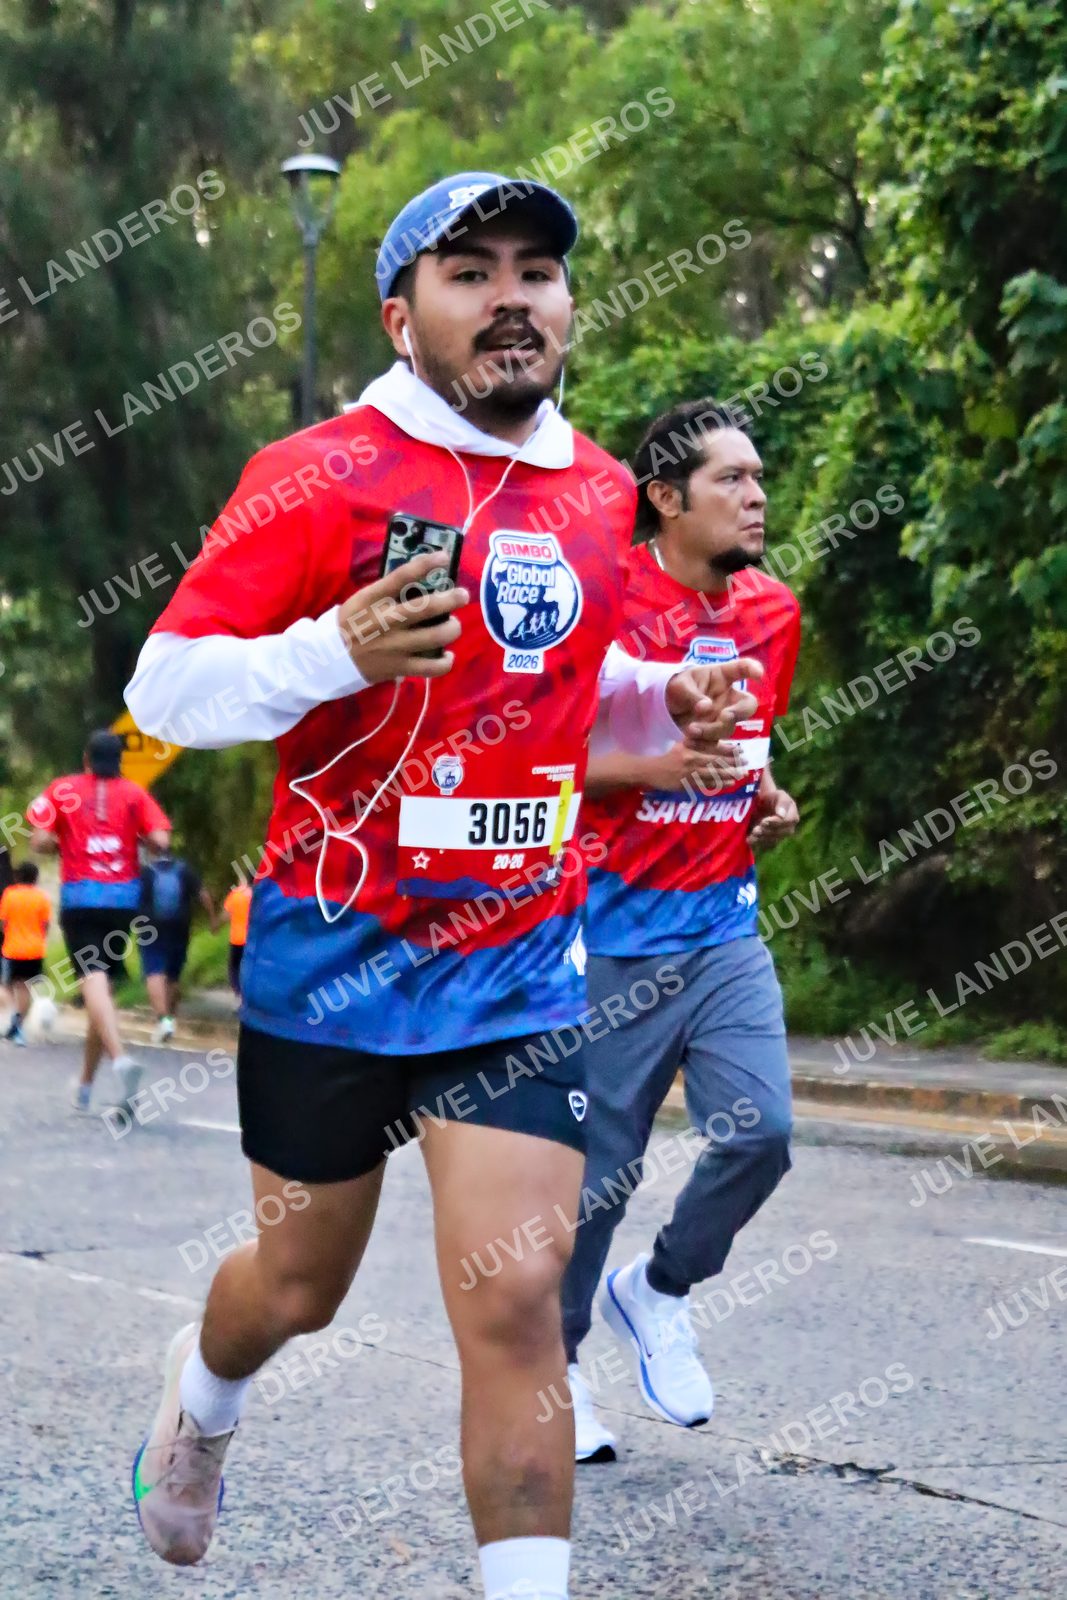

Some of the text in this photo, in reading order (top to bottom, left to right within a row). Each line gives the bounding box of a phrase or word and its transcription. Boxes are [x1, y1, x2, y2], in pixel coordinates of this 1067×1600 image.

[500, 542, 552, 559] BIMBO
[506, 566, 555, 588] Global
[496, 583, 540, 604] Race
[507, 654, 539, 669] 2026
[468, 801, 548, 845] 3056
